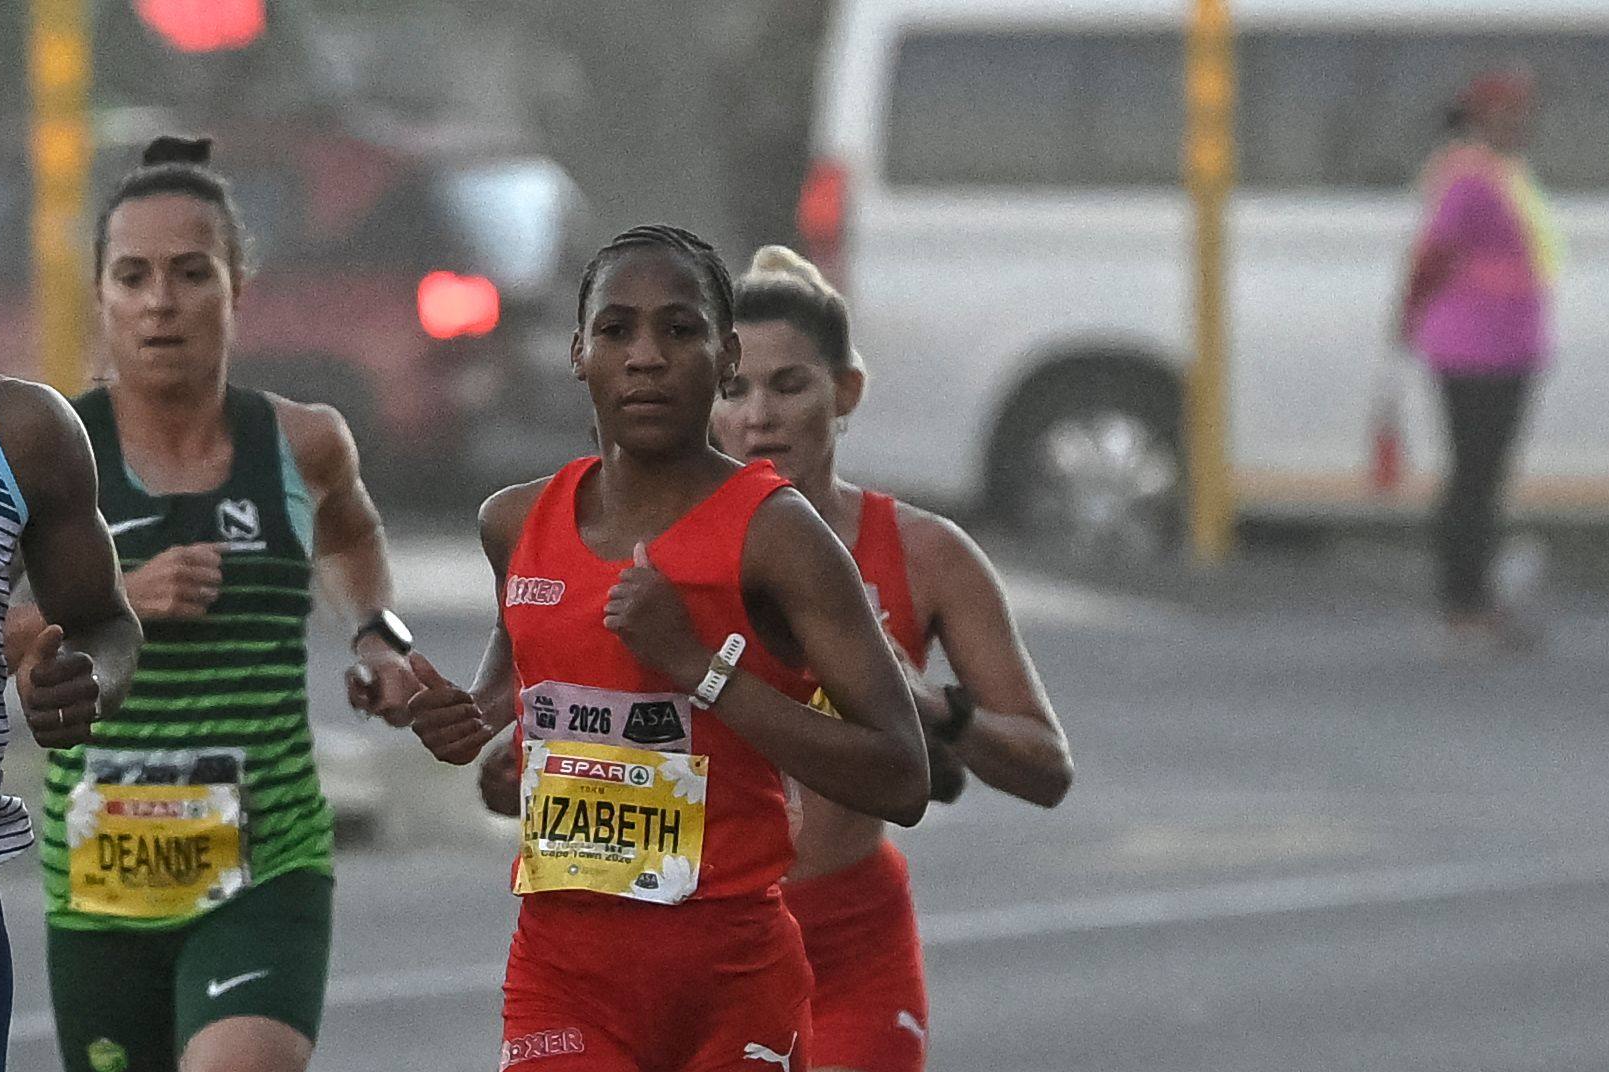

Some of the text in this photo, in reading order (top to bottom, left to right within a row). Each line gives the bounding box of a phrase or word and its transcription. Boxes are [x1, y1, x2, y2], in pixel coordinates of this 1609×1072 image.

[568, 704, 611, 735] 2026
[631, 706, 676, 726] ASA
[560, 759, 624, 780] SPAR
[98, 833, 213, 870] DEANNE
